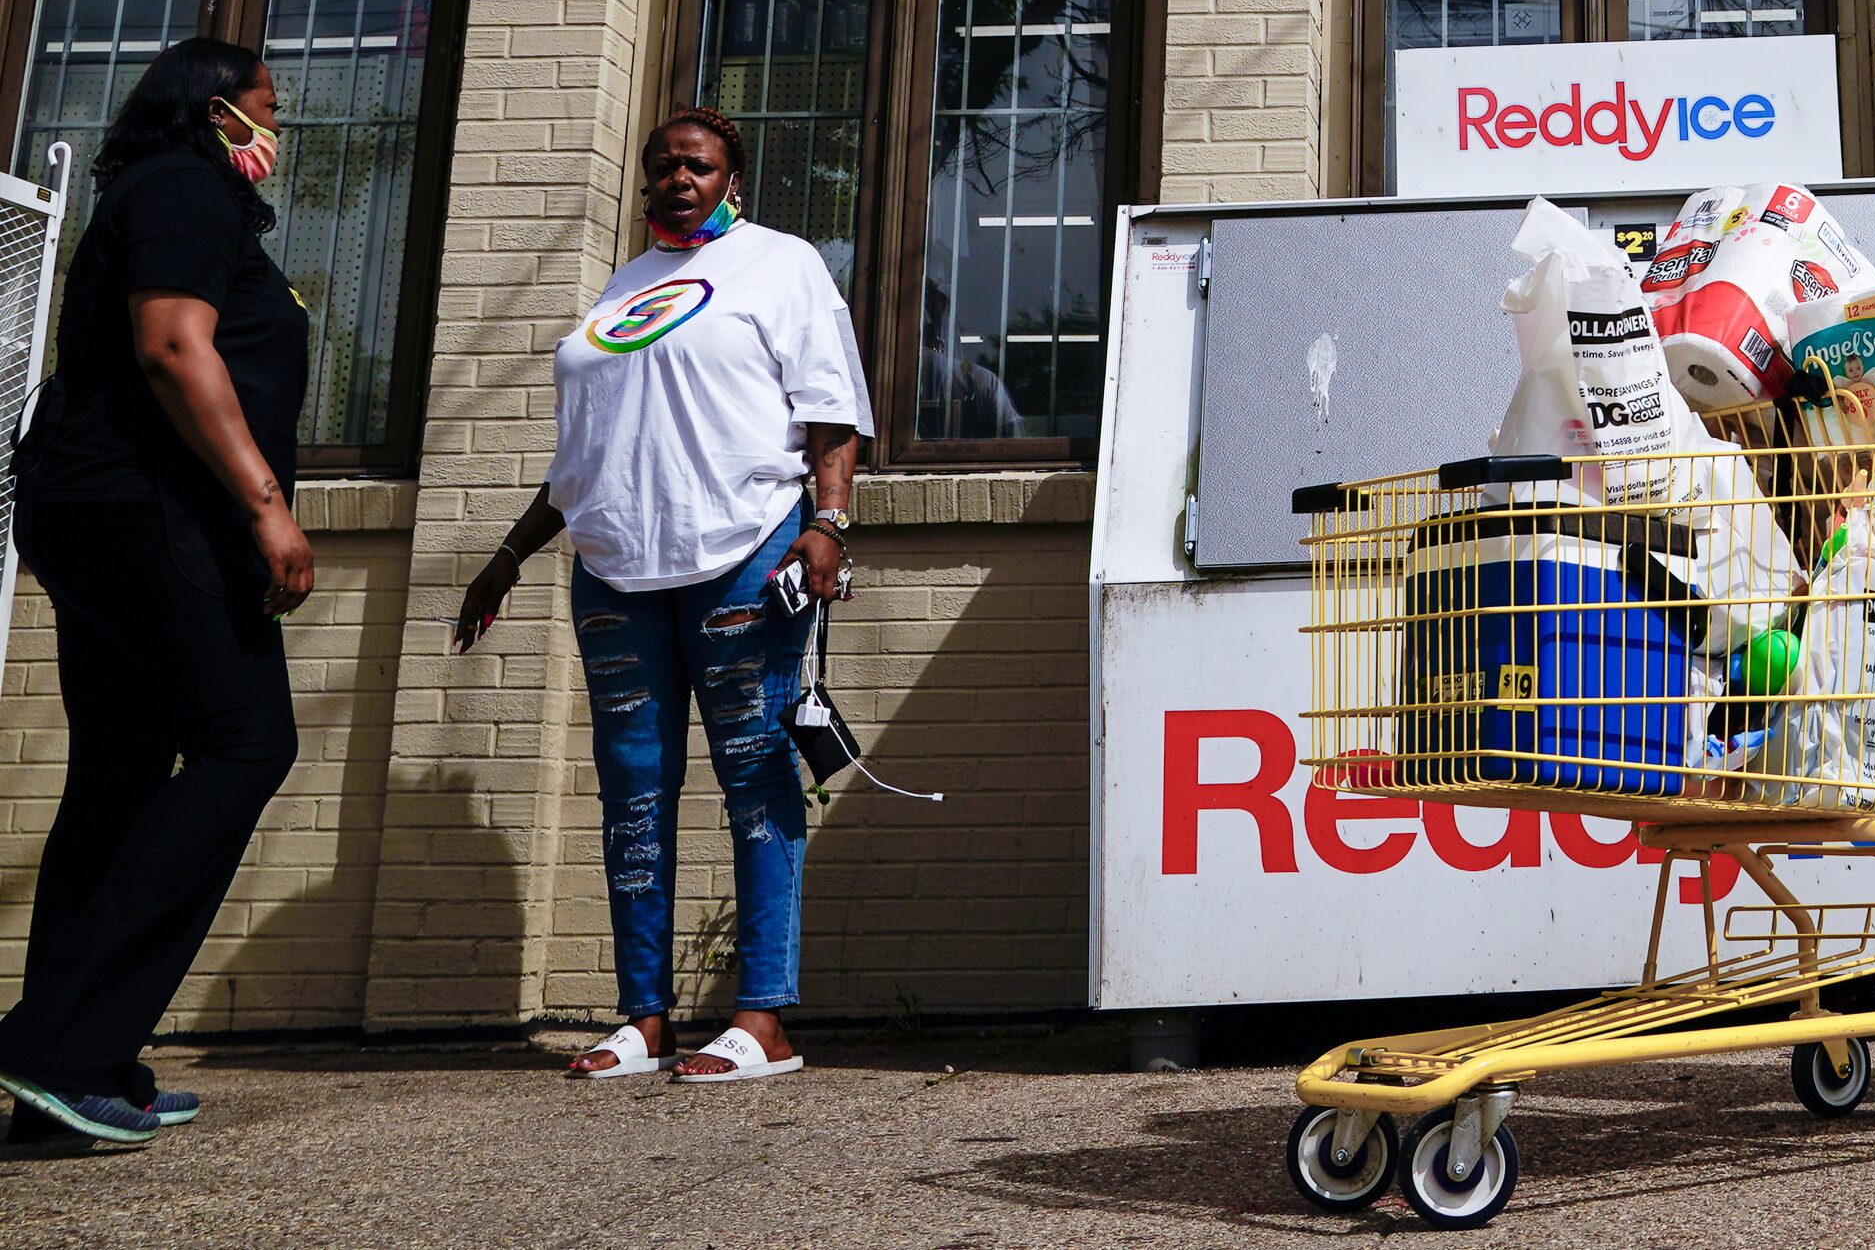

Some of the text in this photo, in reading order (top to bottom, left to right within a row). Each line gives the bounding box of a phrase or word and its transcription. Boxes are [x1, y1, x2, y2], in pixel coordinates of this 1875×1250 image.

[1784, 191, 1802, 210] 6
[1645, 241, 1719, 278] ssential
[1846, 305, 1860, 319] 12
[1570, 319, 1624, 338] OLLAR
[1804, 331, 1864, 369] Angel
[1587, 387, 1619, 399] MORE
[1586, 392, 1662, 431] DG DIGIT
[1630, 408, 1665, 425] COUP
[1606, 484, 1625, 495] Visit
